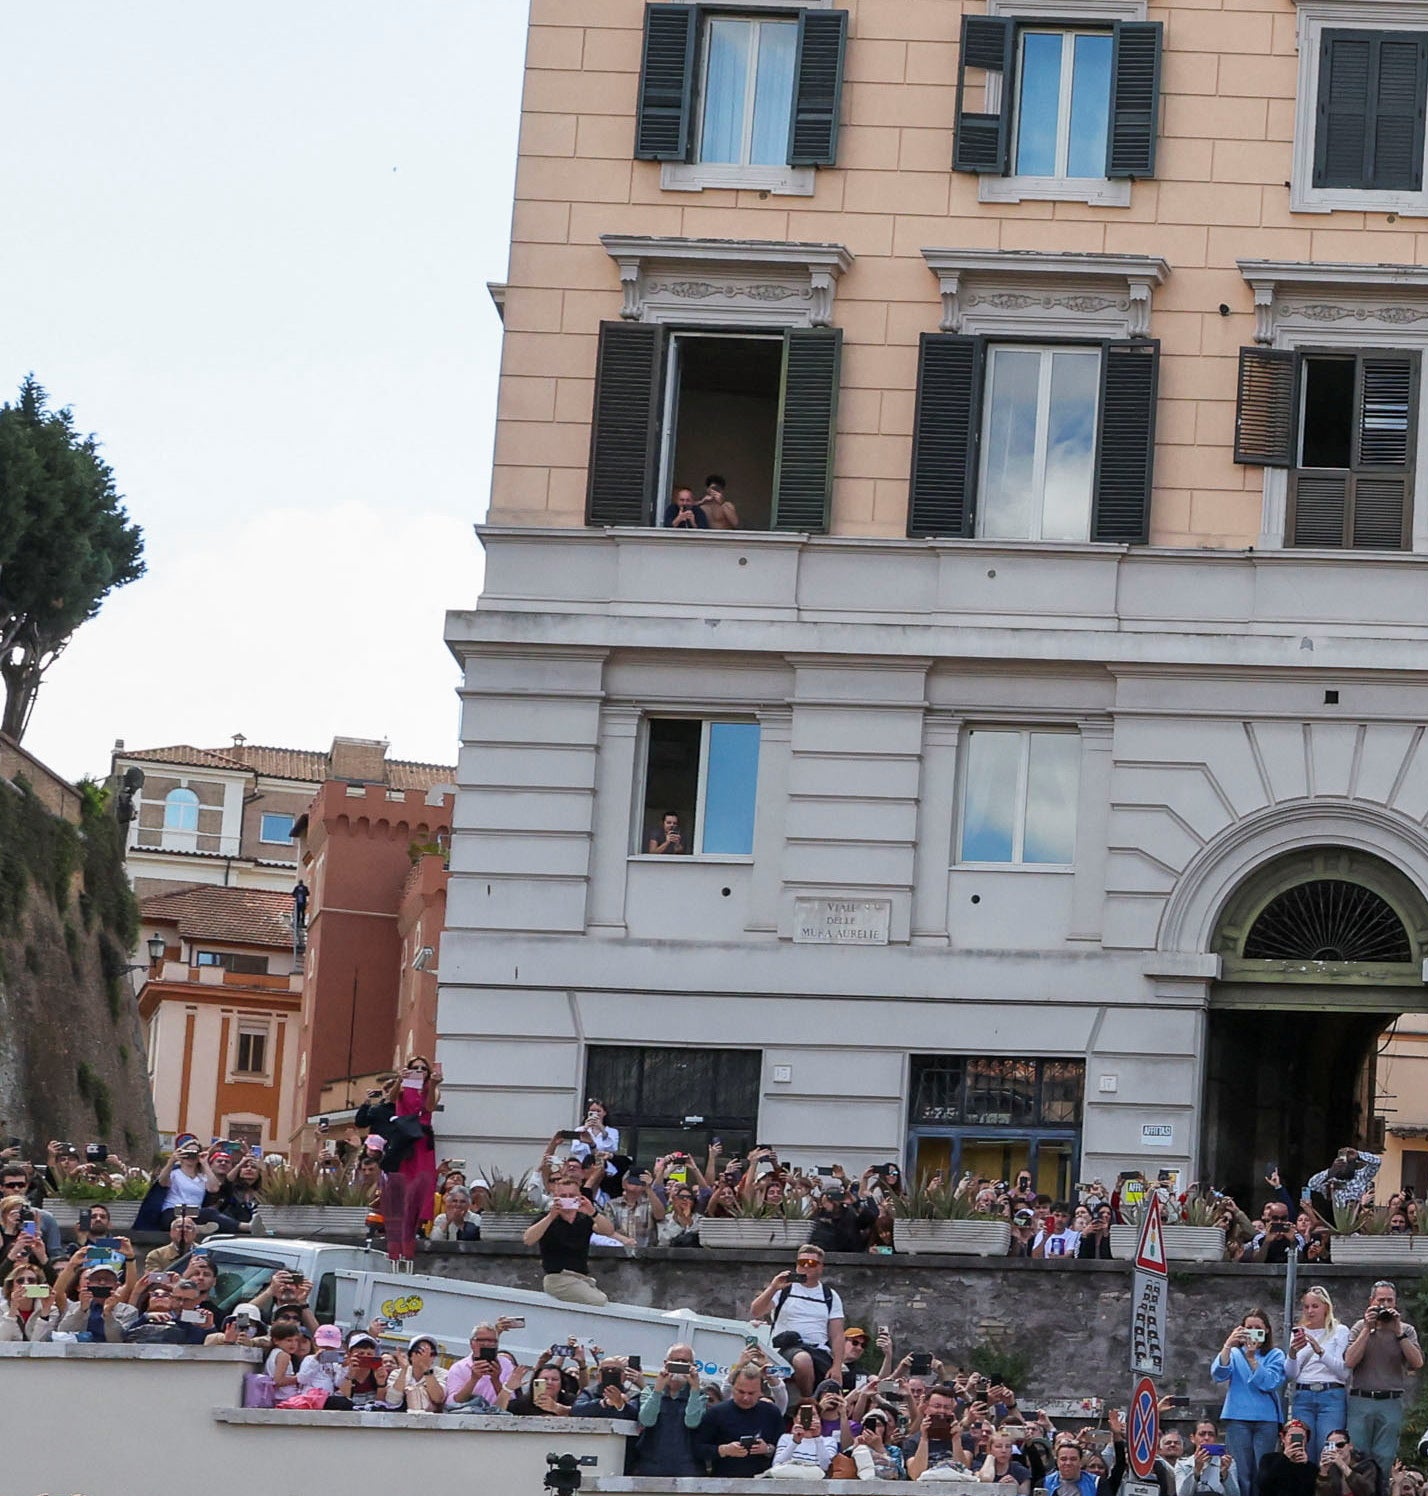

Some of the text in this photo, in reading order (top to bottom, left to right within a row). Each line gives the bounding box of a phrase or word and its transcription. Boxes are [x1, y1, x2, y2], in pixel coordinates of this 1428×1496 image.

[827, 903, 857, 913] VIALE
[826, 916, 857, 925] DELLE
[801, 928, 880, 939] MURA AURELIE
[1144, 1126, 1172, 1137] AFFITTASI
